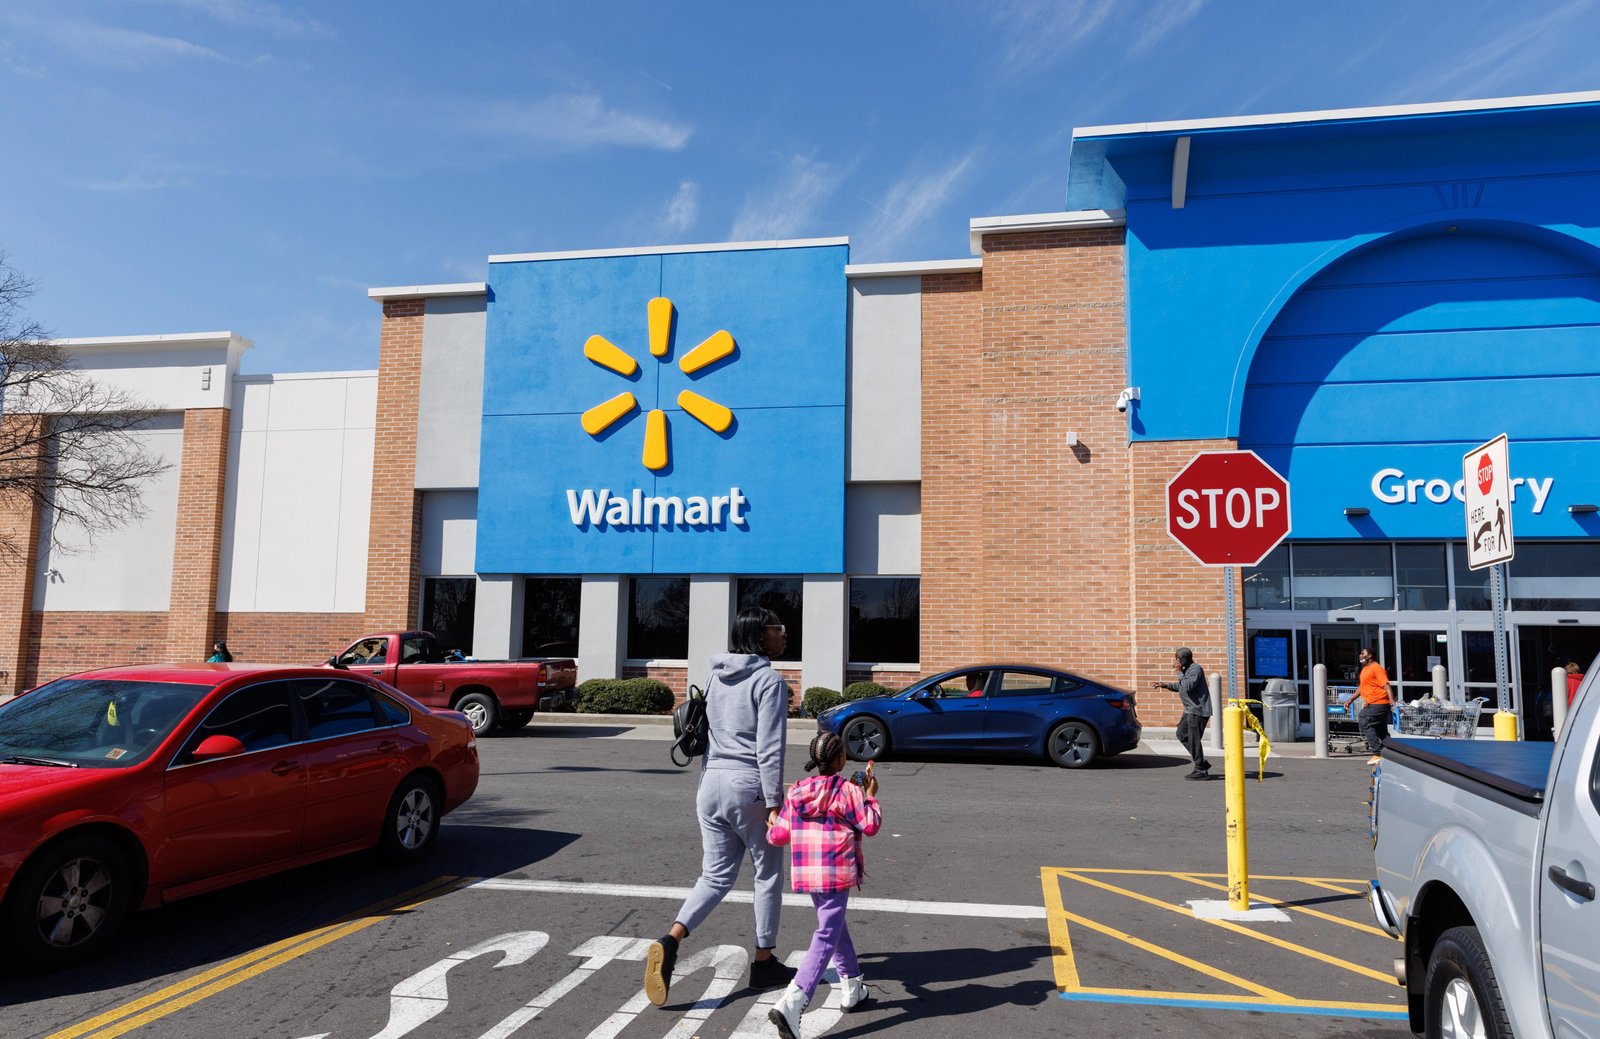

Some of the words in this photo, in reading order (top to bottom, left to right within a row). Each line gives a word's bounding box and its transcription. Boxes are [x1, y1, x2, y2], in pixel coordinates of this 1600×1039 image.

[1478, 465, 1493, 485] STOP
[566, 487, 746, 526] Walmart
[1176, 487, 1280, 530] STOP
[1471, 506, 1485, 524] HERE
[1484, 536, 1496, 553] FOR
